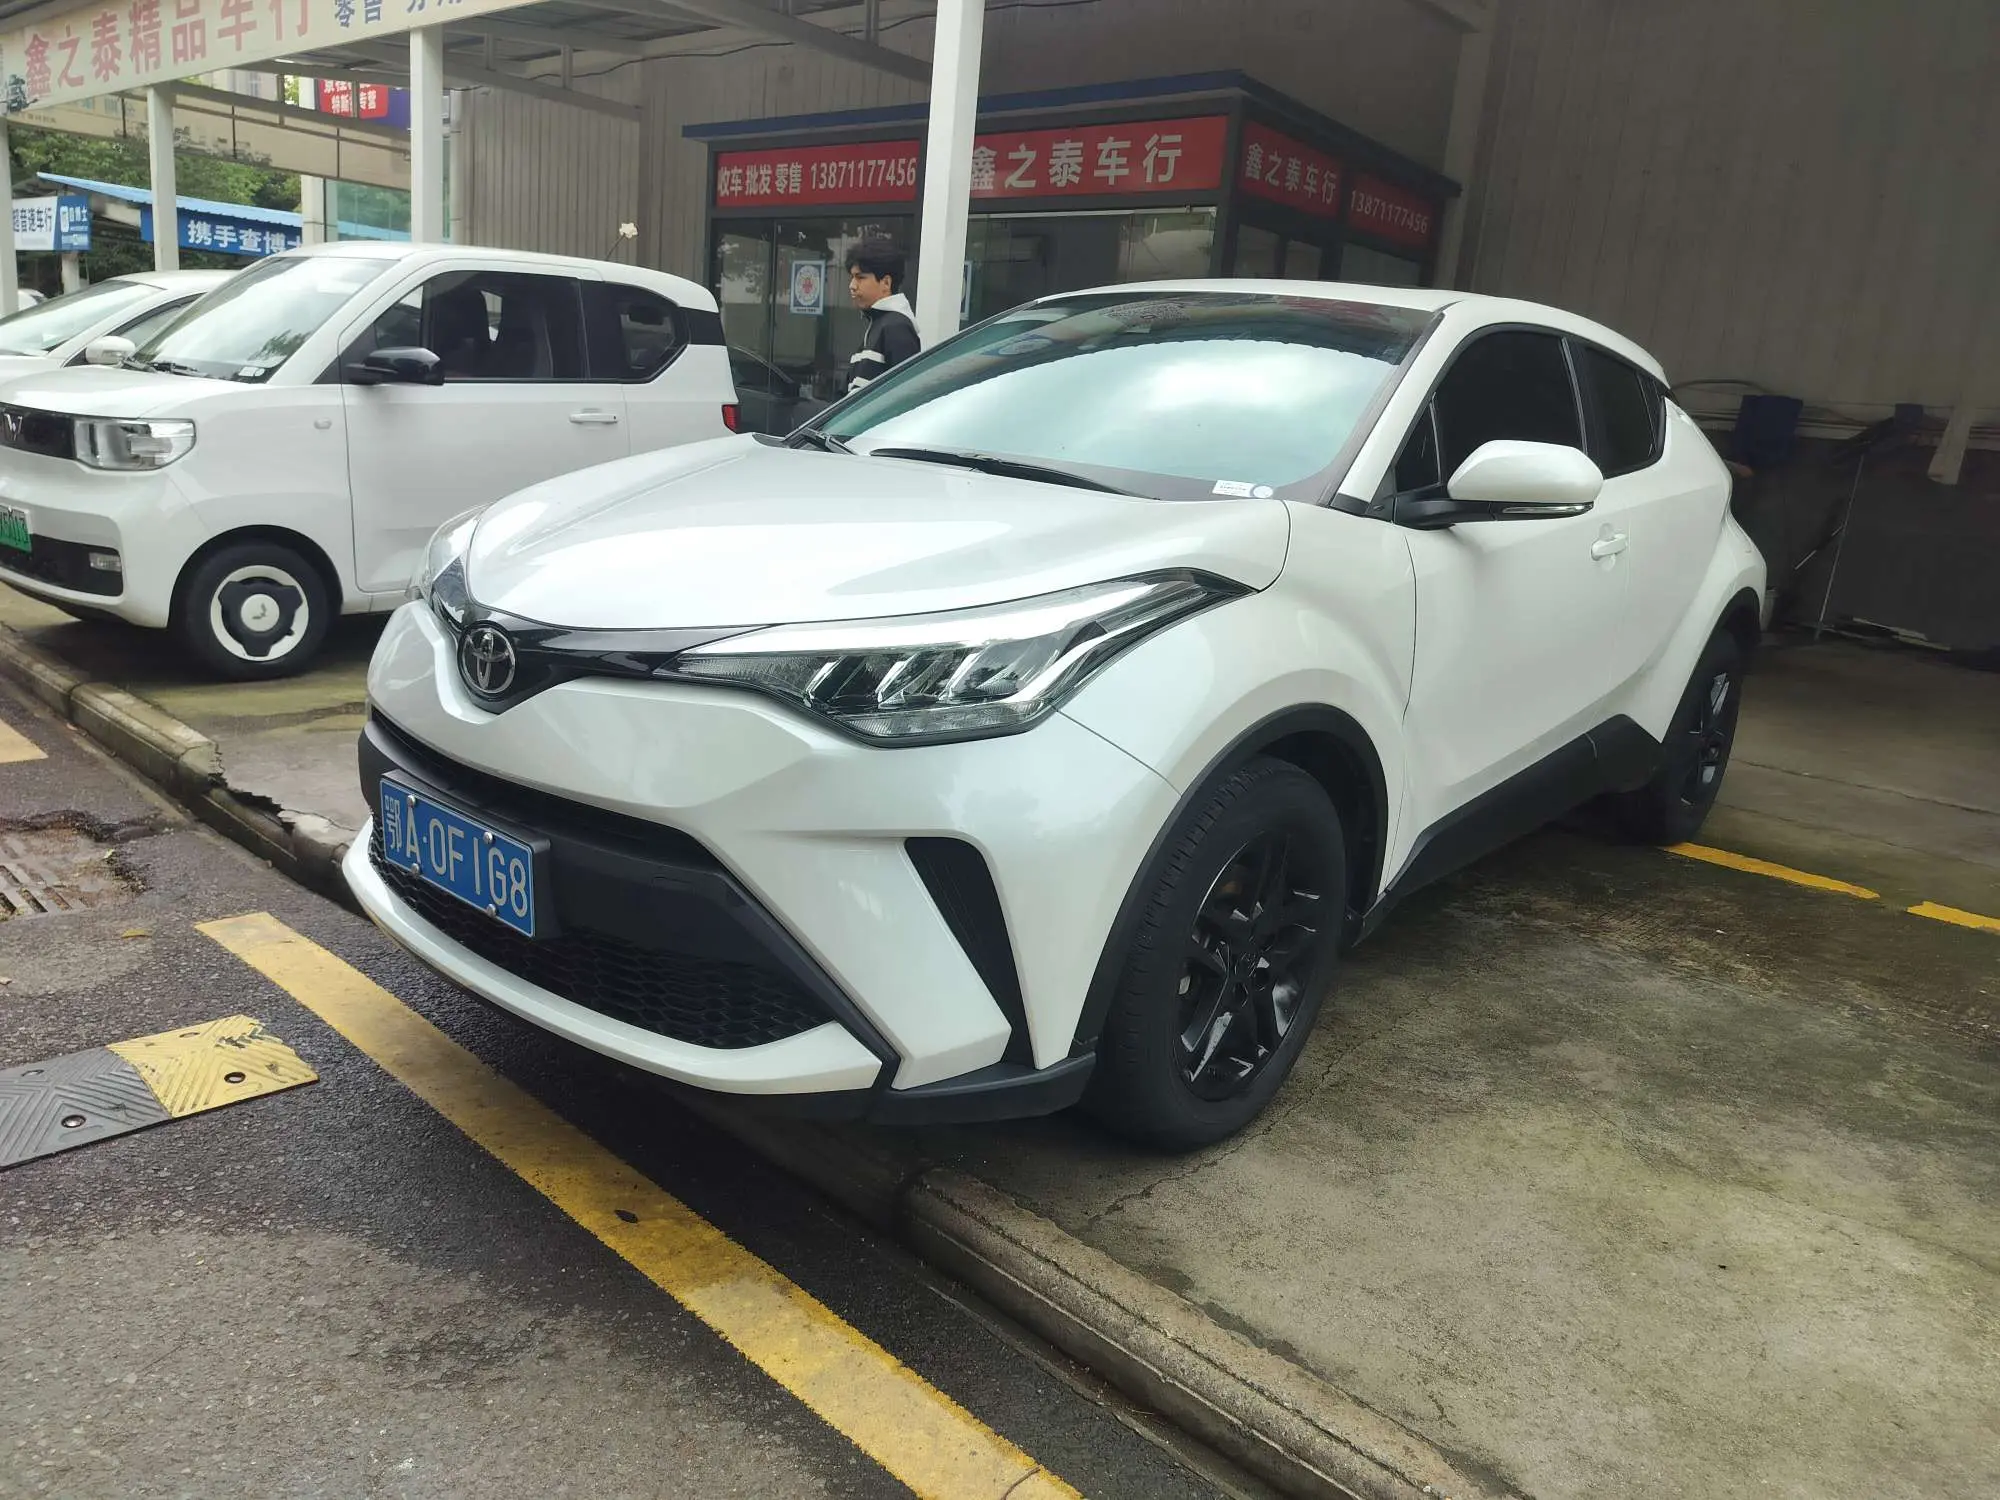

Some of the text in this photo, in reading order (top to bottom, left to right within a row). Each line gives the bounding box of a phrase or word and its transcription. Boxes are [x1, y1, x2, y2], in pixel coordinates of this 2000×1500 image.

[331, 90, 376, 114] 特斯专营
[717, 157, 917, 198] 收车 批发 零售 13871177456
[970, 133, 1182, 190] 鑫之泰车行
[1245, 142, 1337, 205] 鑫之泰车行
[1350, 189, 1429, 235] 13871177456
